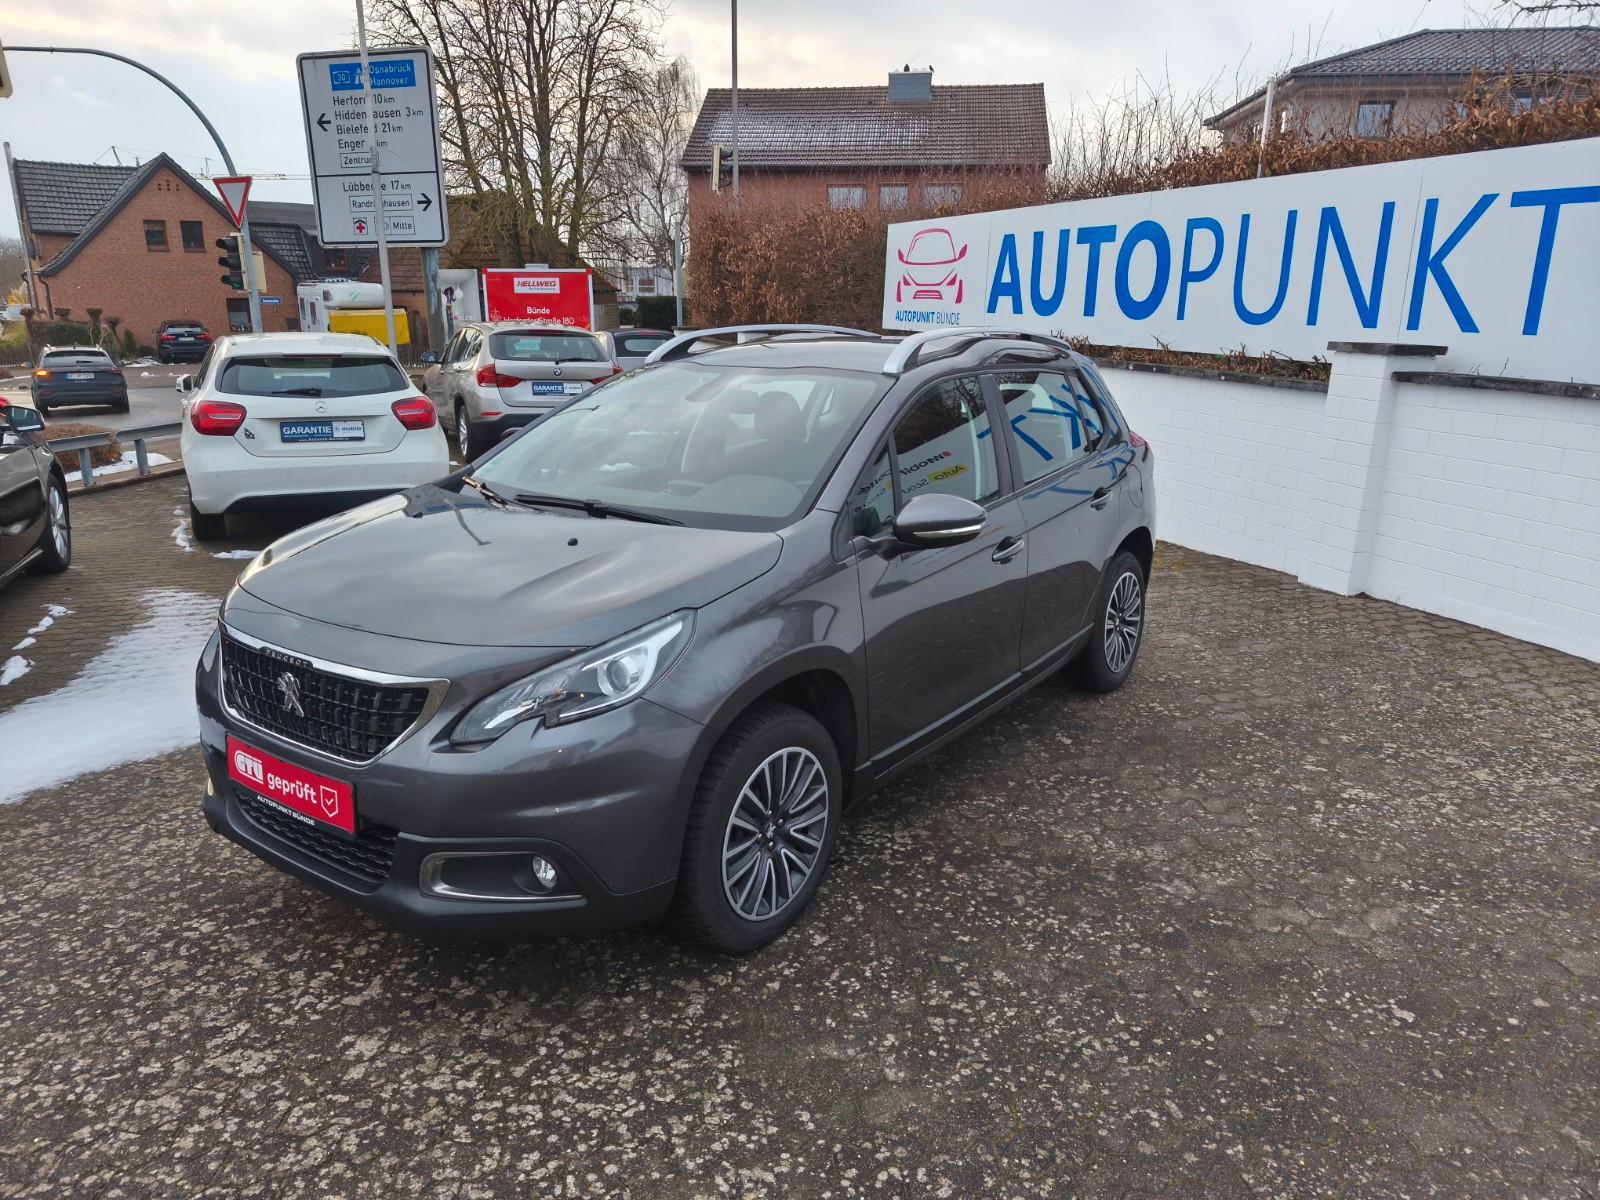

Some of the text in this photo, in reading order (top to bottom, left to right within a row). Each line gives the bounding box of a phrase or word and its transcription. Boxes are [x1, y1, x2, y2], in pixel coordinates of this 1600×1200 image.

[337, 73, 409, 86] 30 Hannover
[373, 93, 383, 104] 10
[383, 96, 395, 104] km
[335, 106, 424, 120] Hiddenausen 3 km
[382, 122, 391, 133] 21
[338, 138, 388, 151] Enger km
[344, 156, 372, 165] Zentru
[390, 180, 399, 191] 17
[393, 221, 412, 230] Mitte
[987, 186, 1600, 336] AUTOPUNKT
[517, 280, 556, 288] HELLWEG
[526, 306, 550, 314] Bünde
[562, 317, 575, 325] 180
[895, 310, 935, 323] AUTOPUNKT
[283, 425, 332, 435] GARANTIE
[267, 773, 317, 804] geprüft
[257, 795, 292, 816] AUTOPUNKT
